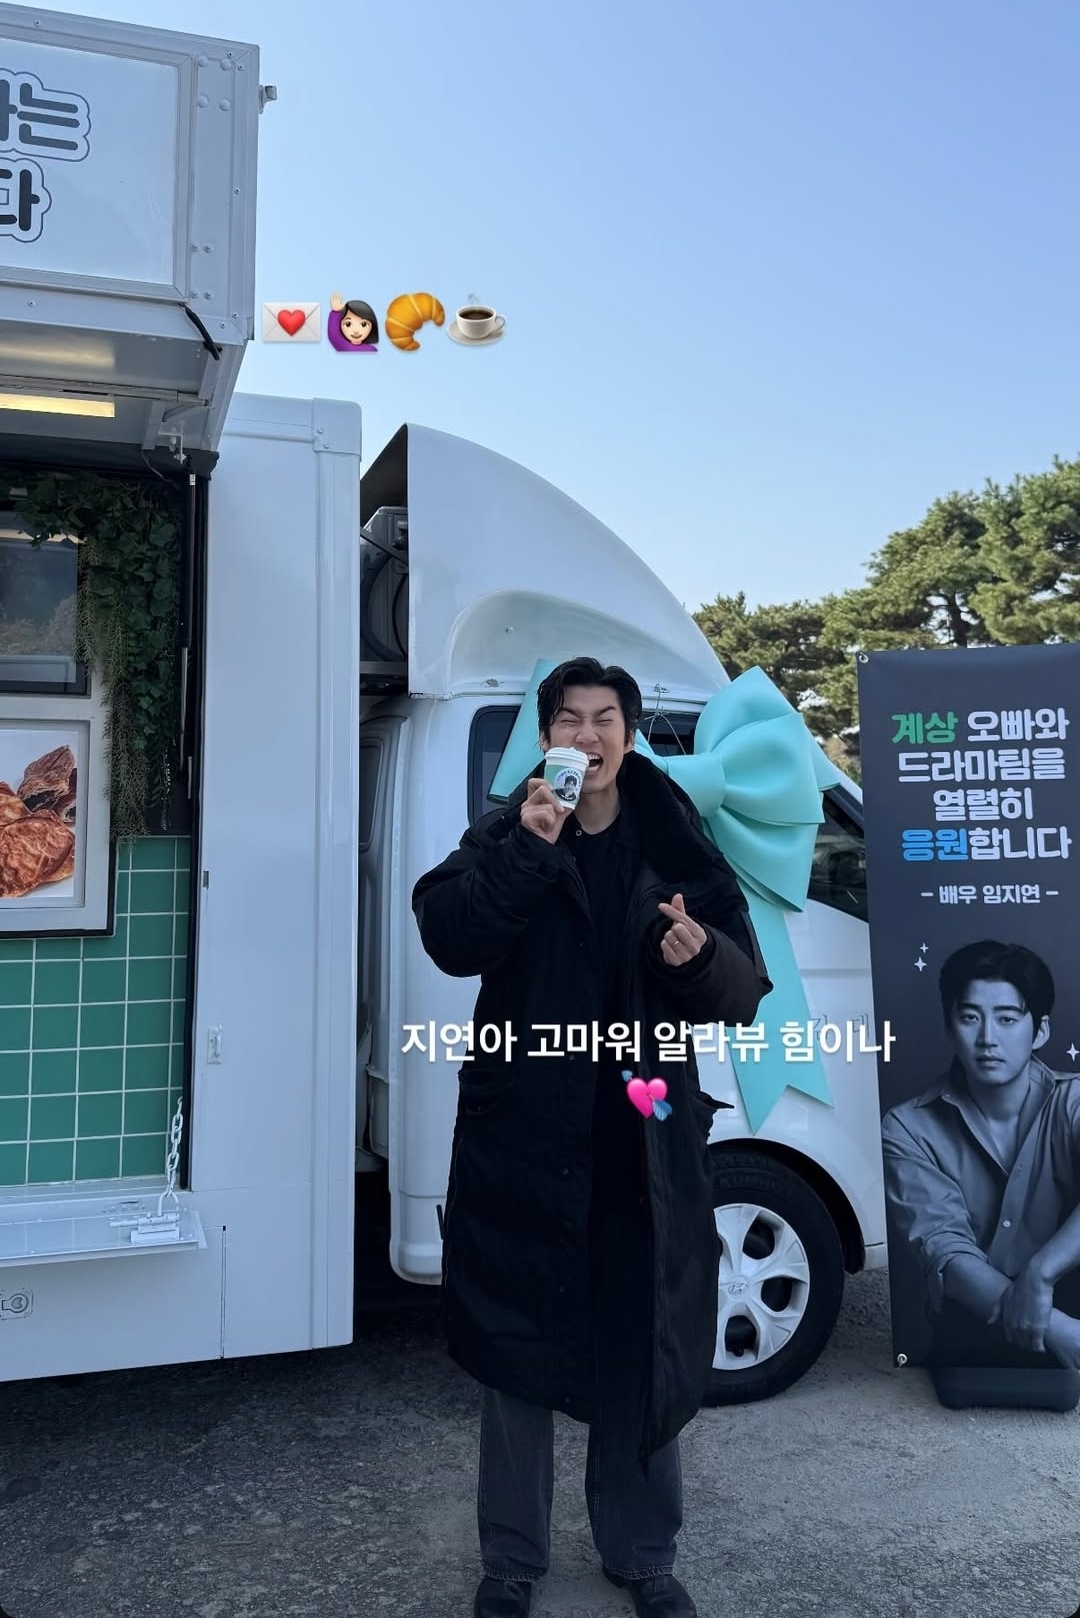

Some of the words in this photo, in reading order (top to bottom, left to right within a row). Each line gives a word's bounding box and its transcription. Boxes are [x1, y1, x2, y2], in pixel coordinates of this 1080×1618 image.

[891, 711, 959, 744] 계상
[967, 707, 1070, 742] 오빠와
[898, 747, 1067, 783] 드라마팀을
[933, 787, 1034, 822] 열렬히
[901, 826, 1073, 862] 응원합니다
[938, 885, 978, 905] 배우
[982, 884, 1041, 905] 임지연
